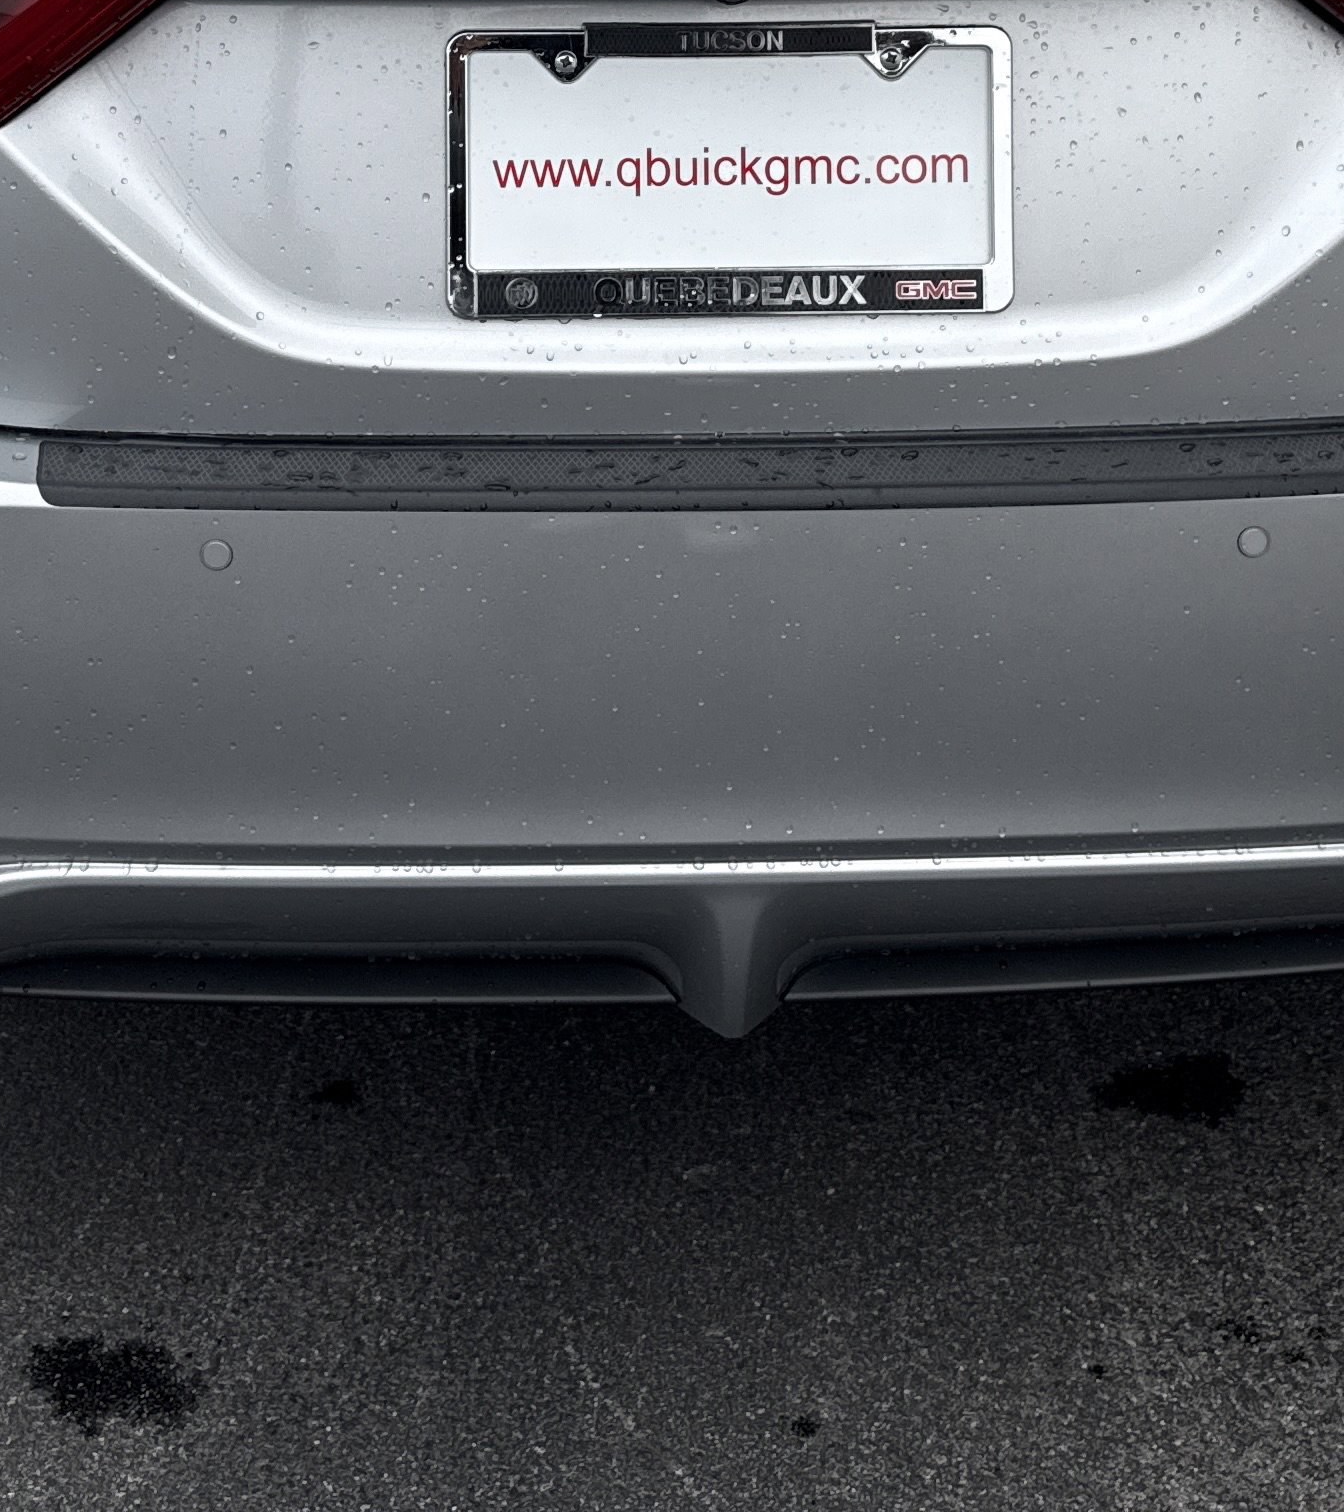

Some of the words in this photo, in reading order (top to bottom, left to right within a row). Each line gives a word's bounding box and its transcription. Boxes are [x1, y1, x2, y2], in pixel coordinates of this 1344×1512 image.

[678, 30, 784, 52] TUCSON
[492, 146, 969, 197] www.qbuickgmc.com
[593, 275, 867, 307] QUEBEDEAUX
[896, 279, 977, 300] GMC
